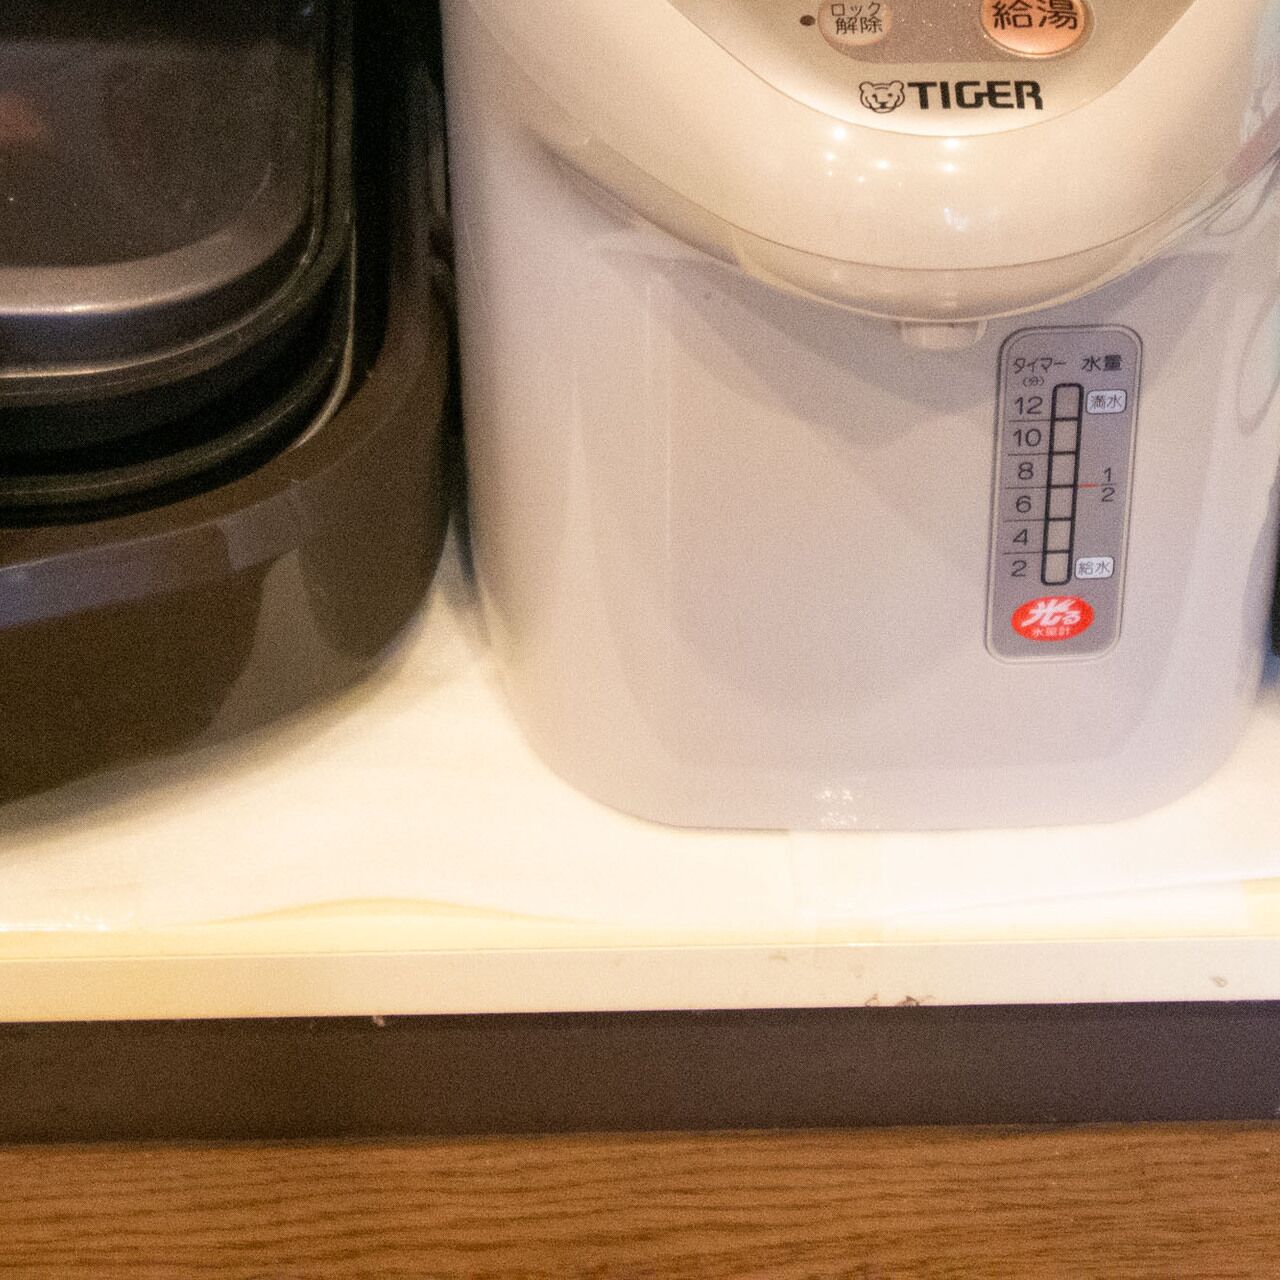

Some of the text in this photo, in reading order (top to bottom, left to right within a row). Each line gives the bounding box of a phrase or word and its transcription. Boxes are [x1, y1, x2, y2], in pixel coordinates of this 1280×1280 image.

[831, 1, 882, 17] ロック
[835, 16, 883, 35] 解除
[907, 80, 1044, 111] TIGER
[1013, 354, 1123, 374] タイマー 水量
[1022, 376, 1045, 387] (分)
[1015, 396, 1044, 415] 12
[1089, 394, 1123, 410] 満水
[1013, 428, 1042, 447] 10
[1017, 462, 1034, 481] 8
[1015, 495, 1032, 513] 6
[1013, 528, 1029, 546] 4
[1010, 560, 1027, 578] 2
[1077, 560, 1112, 576] 給水
[1021, 599, 1081, 627] 光る
